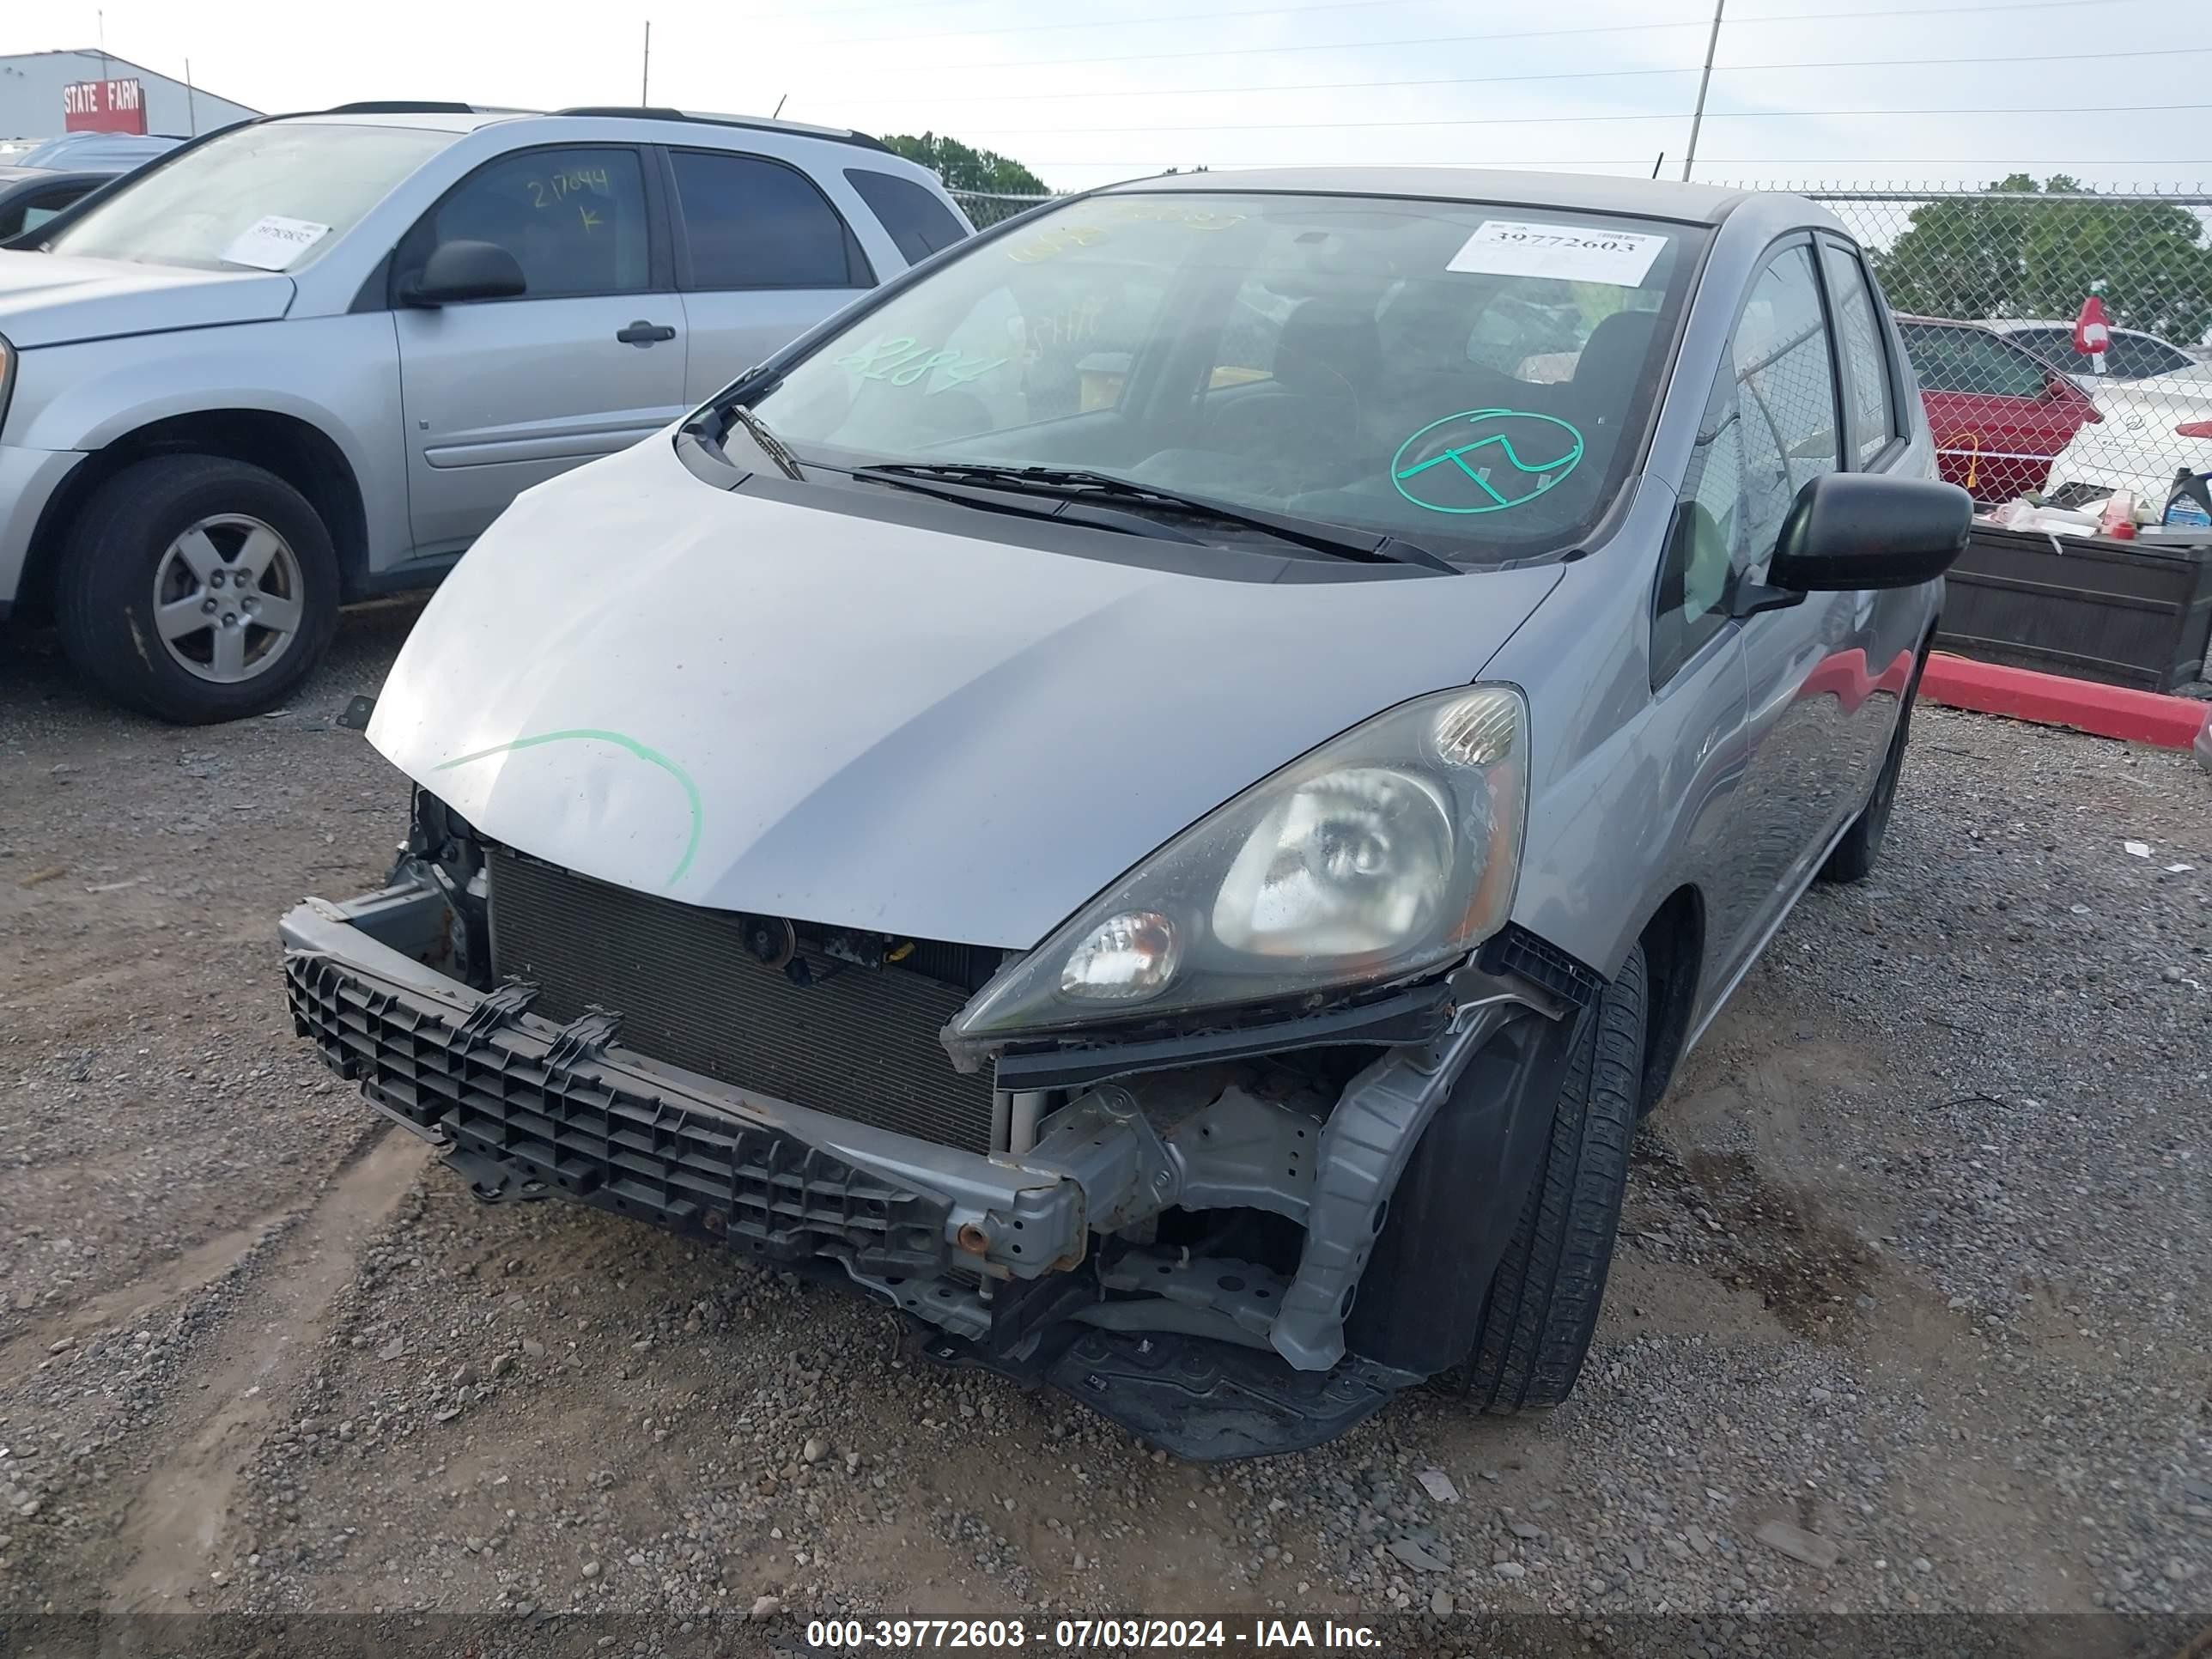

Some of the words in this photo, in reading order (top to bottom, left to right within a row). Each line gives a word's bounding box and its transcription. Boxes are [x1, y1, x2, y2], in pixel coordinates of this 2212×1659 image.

[64, 84, 98, 113] STATE
[107, 80, 139, 111] FARM
[527, 168, 610, 209] 217044
[1490, 232, 1637, 253] 39772603
